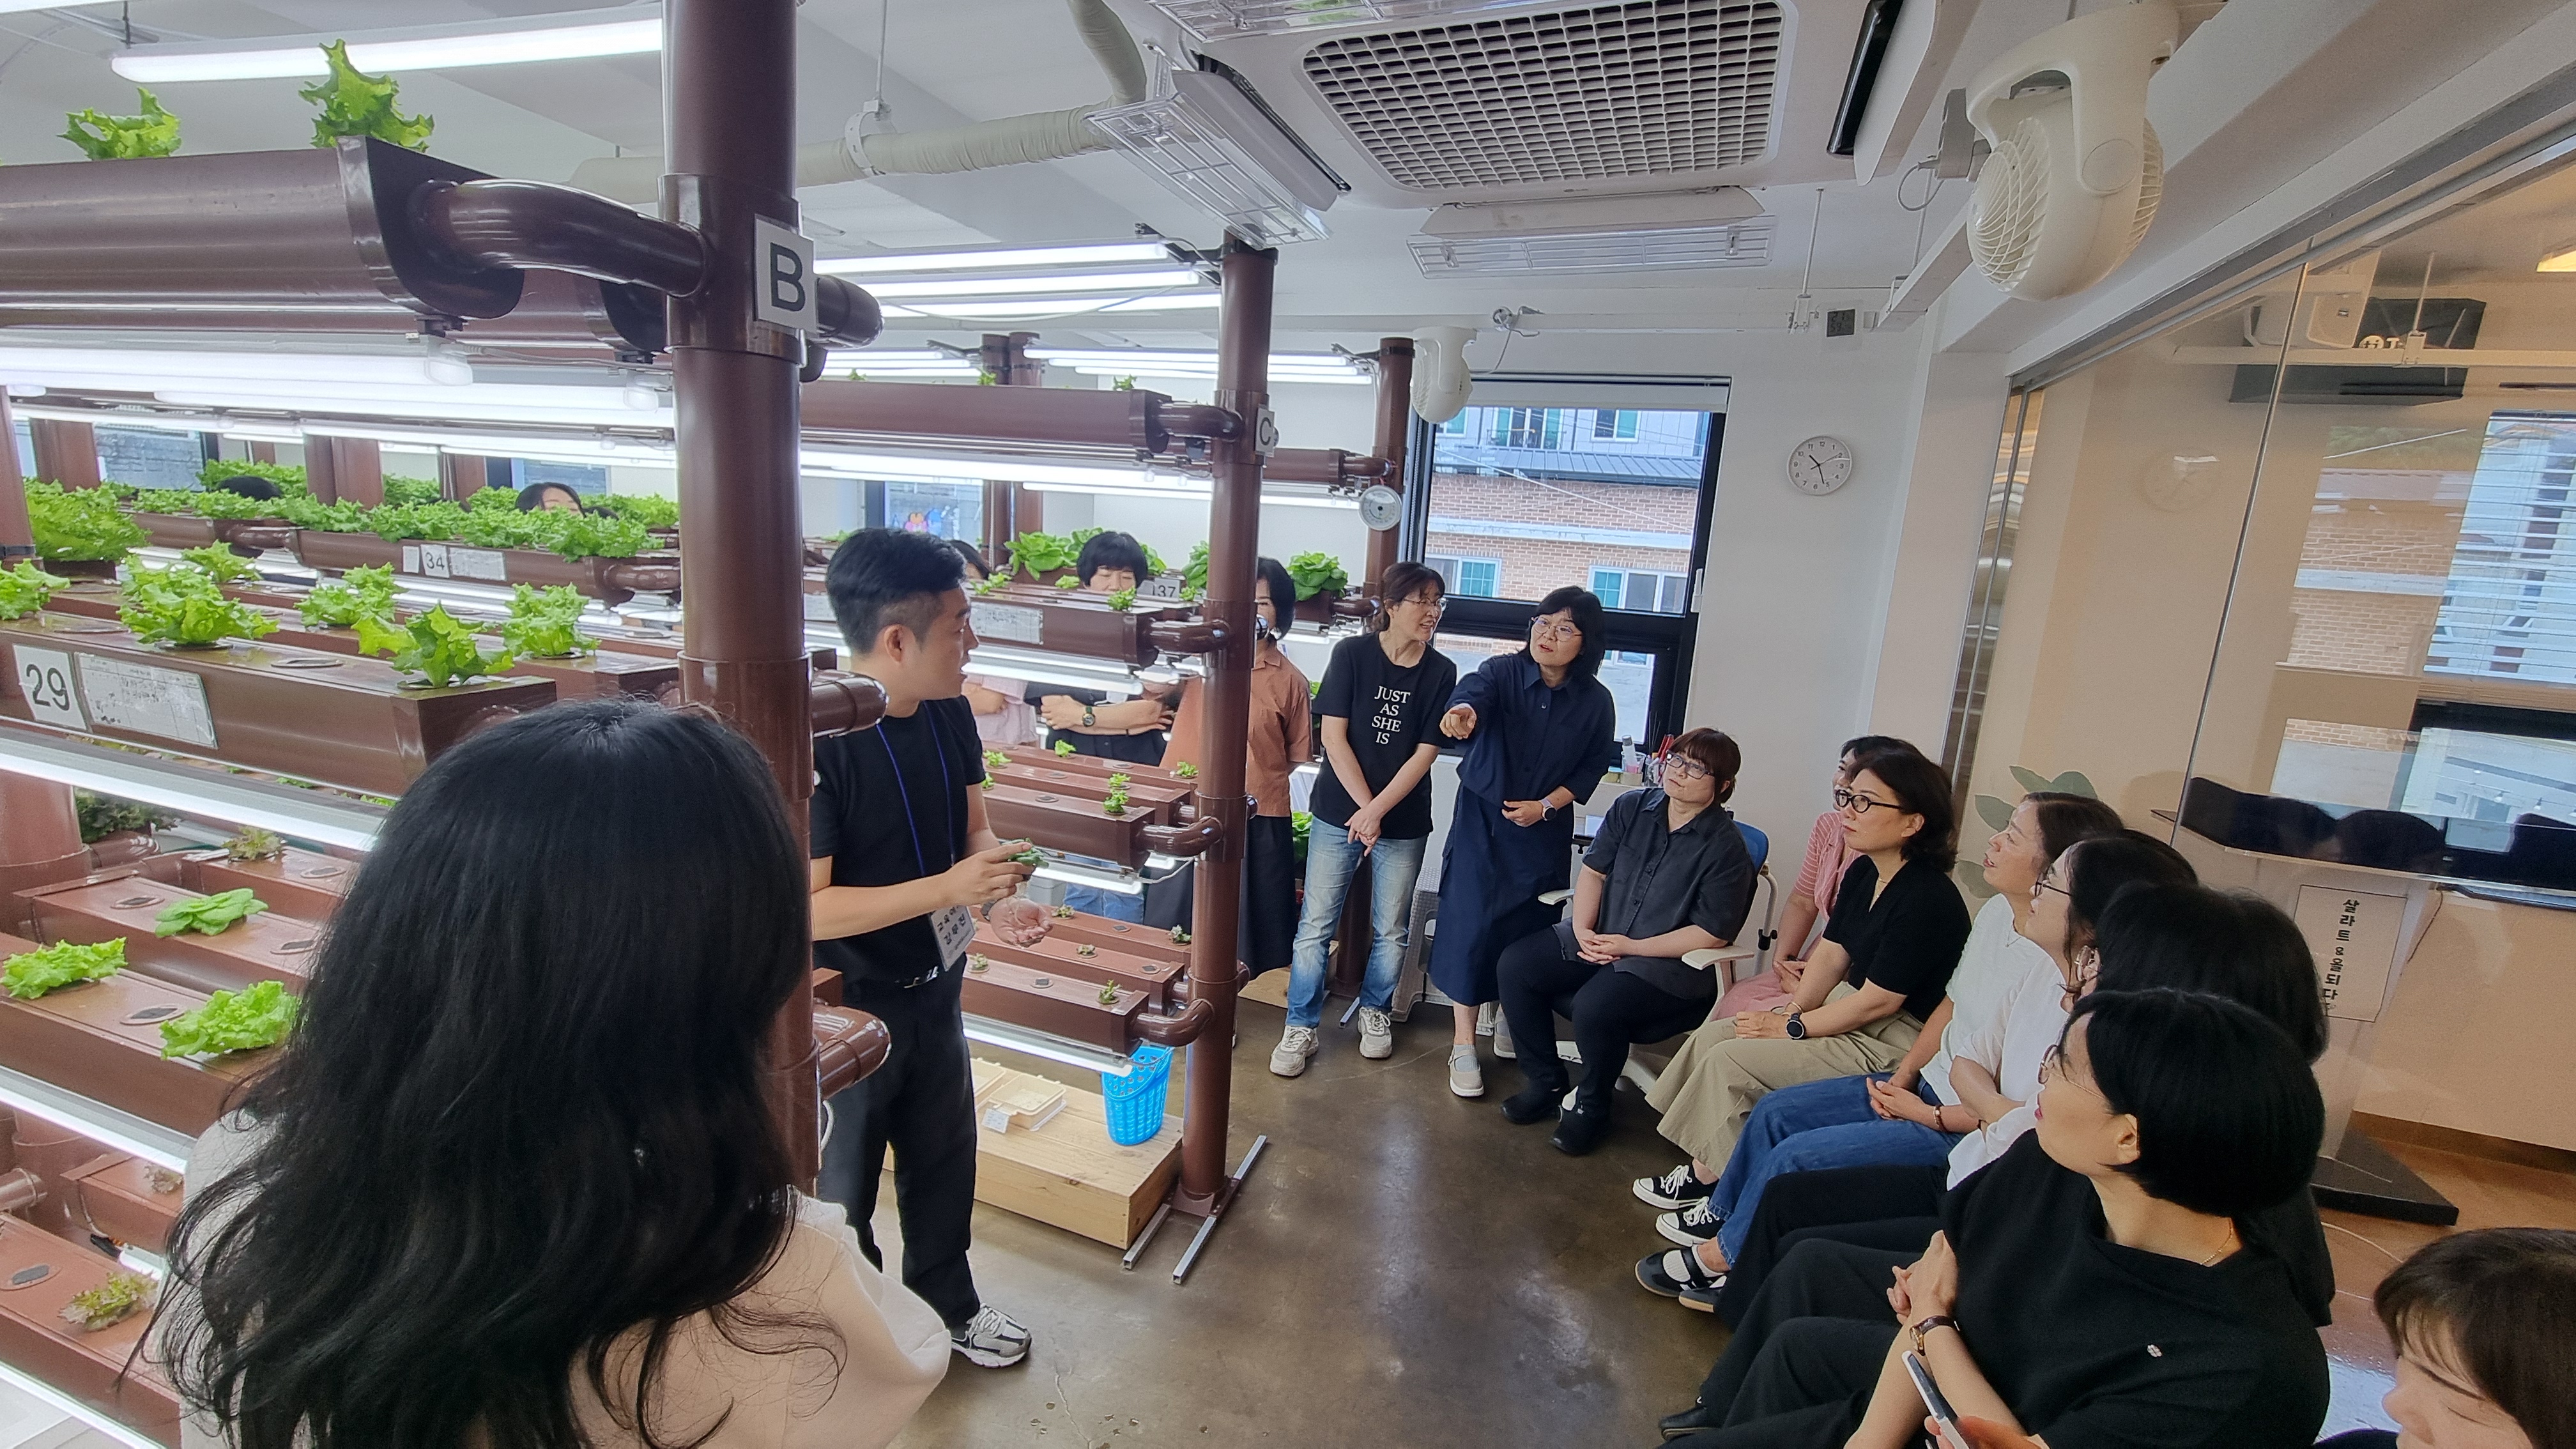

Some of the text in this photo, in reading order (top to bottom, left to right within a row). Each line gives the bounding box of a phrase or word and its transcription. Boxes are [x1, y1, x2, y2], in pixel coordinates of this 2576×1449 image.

[770, 241, 806, 312] B
[1259, 417, 1272, 446] C
[425, 551, 445, 571] 34
[26, 663, 70, 711] 29
[1374, 685, 1411, 703] JUST
[1379, 703, 1400, 716] AS
[1371, 716, 1402, 733] SHE
[1376, 731, 1390, 744] IS
